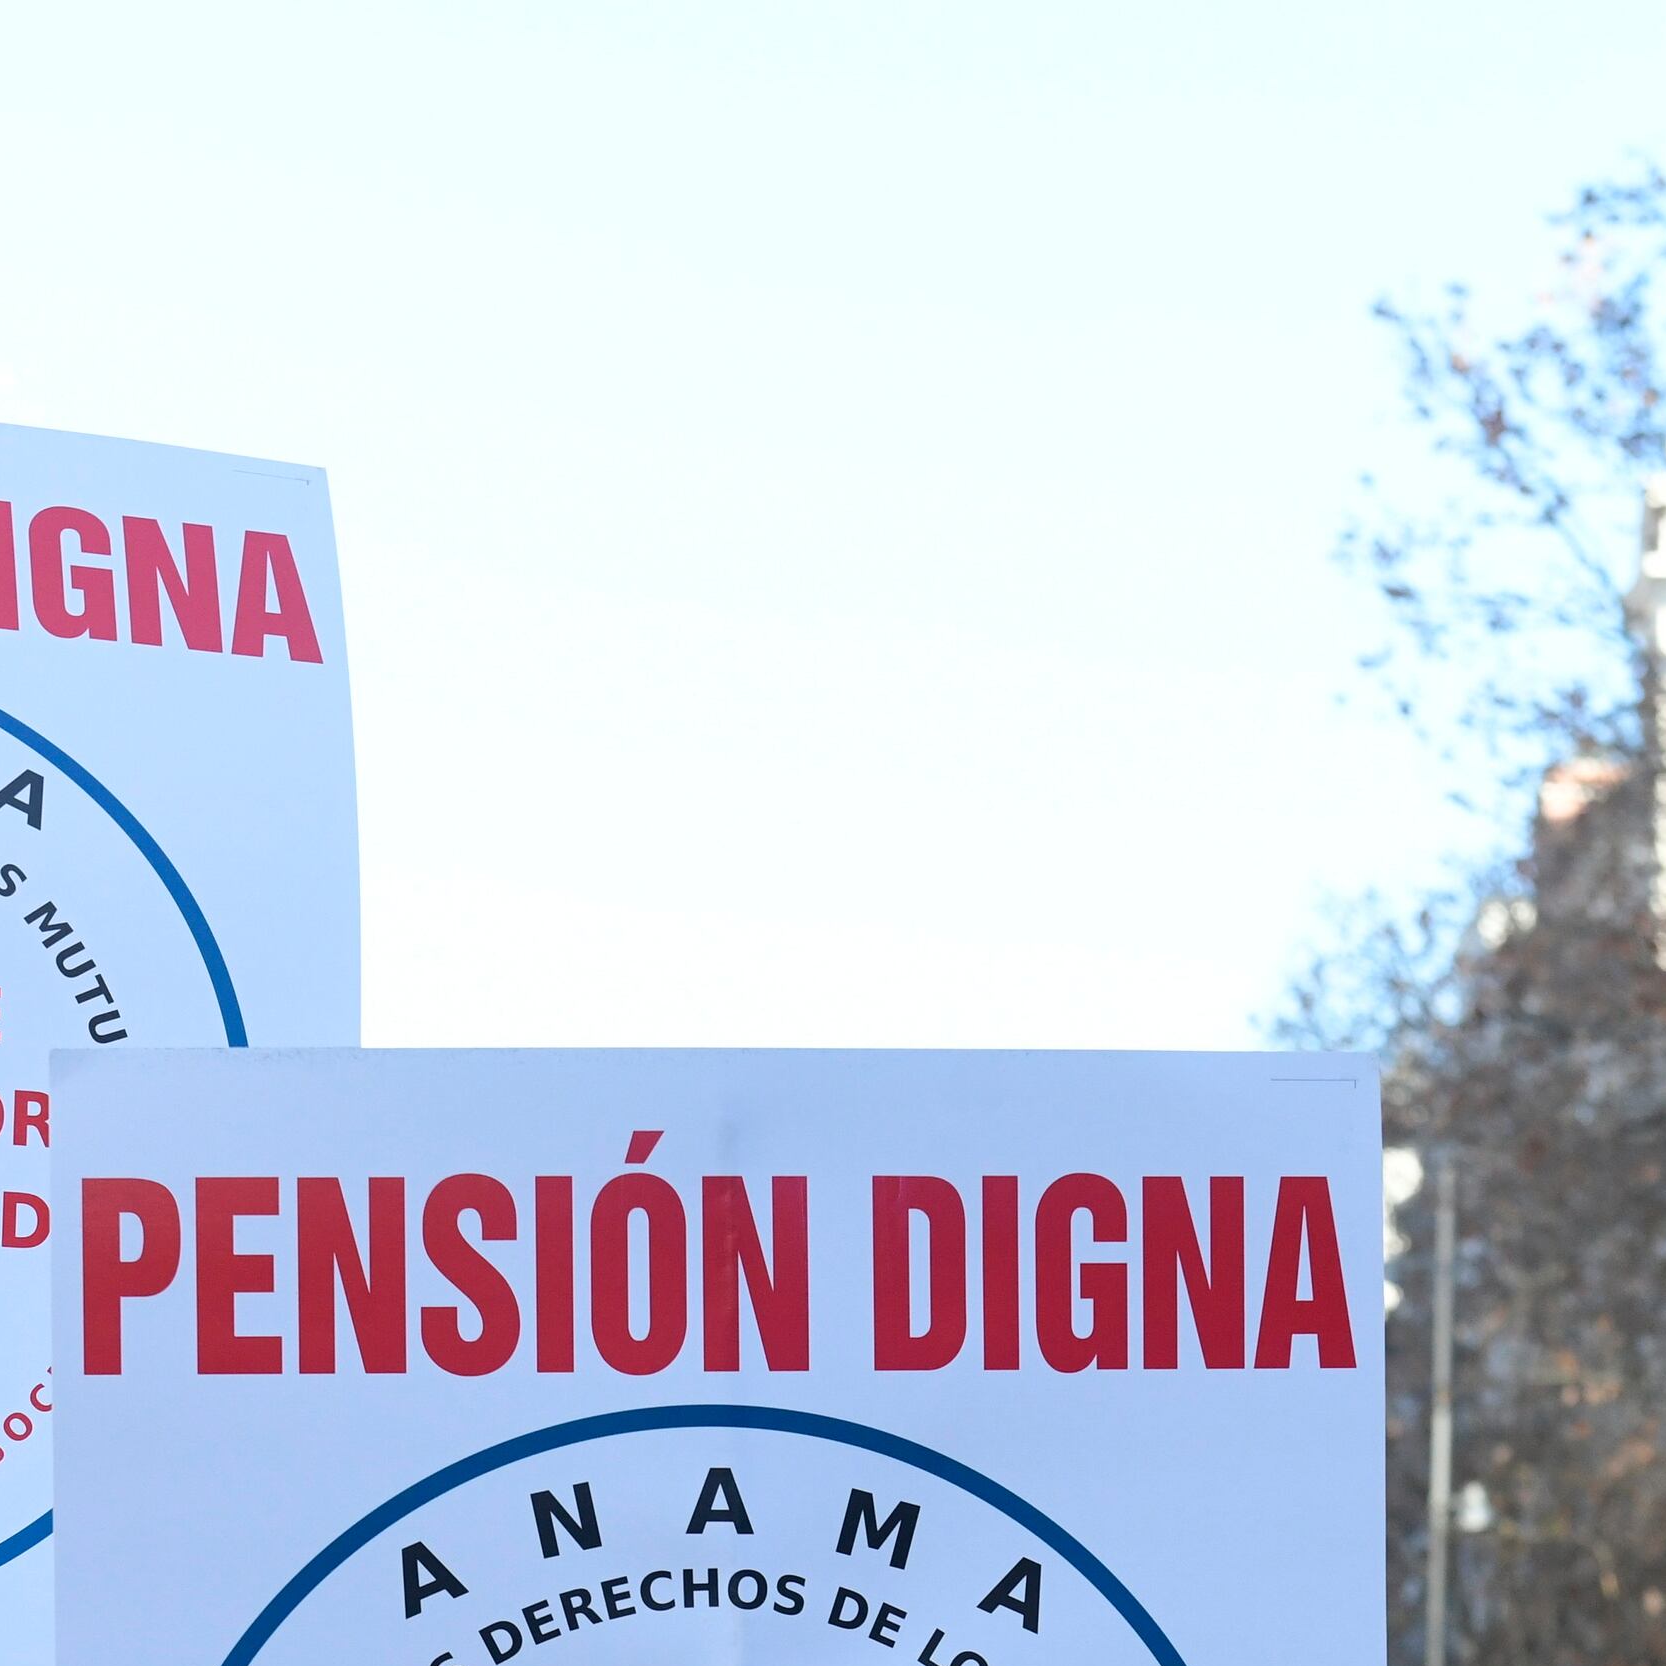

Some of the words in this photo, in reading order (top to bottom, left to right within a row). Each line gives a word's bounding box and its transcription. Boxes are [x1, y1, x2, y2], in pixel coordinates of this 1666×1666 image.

[81, 1130, 810, 1377] PENSIÓN
[872, 1173, 1357, 1374] DIGNA
[478, 1568, 805, 1665] DERECHOS
[828, 1587, 907, 1648] DE
